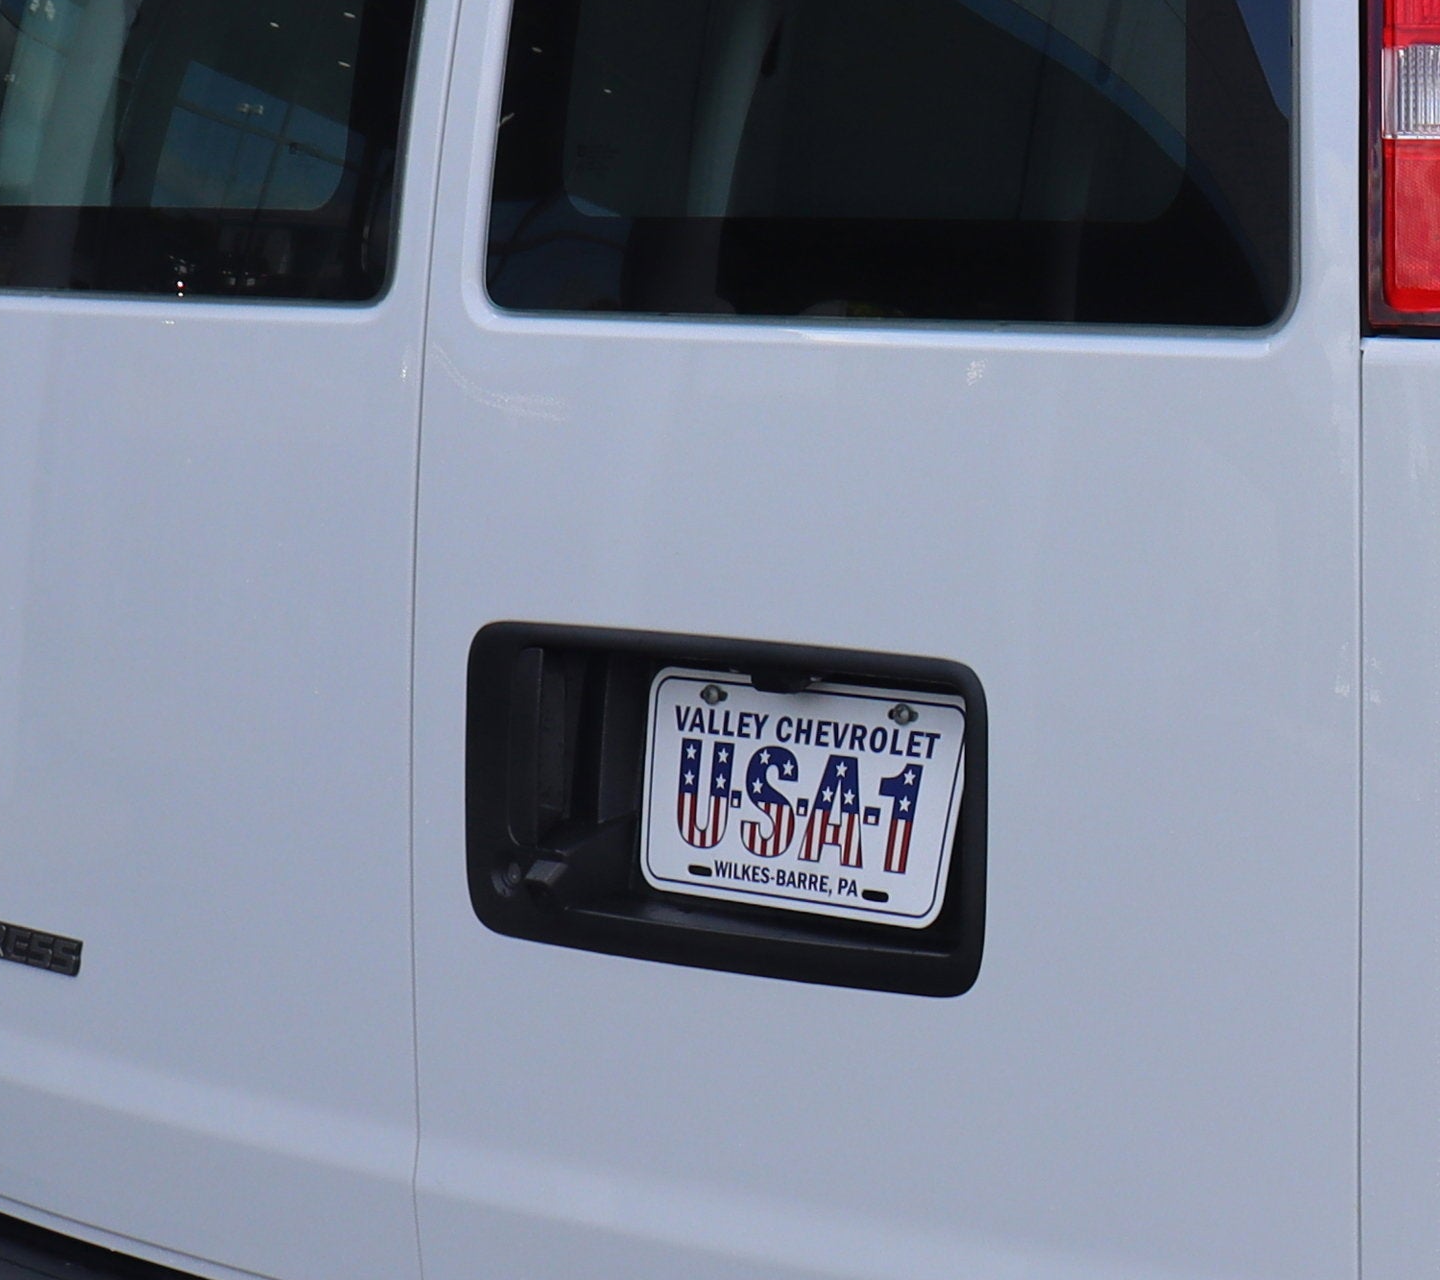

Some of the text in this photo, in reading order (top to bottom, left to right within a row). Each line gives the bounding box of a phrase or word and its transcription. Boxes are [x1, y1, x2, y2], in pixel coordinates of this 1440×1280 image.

[674, 705, 941, 759] VALLEY CHEVROLET
[713, 860, 859, 898] WILKES-BARRE, PA
